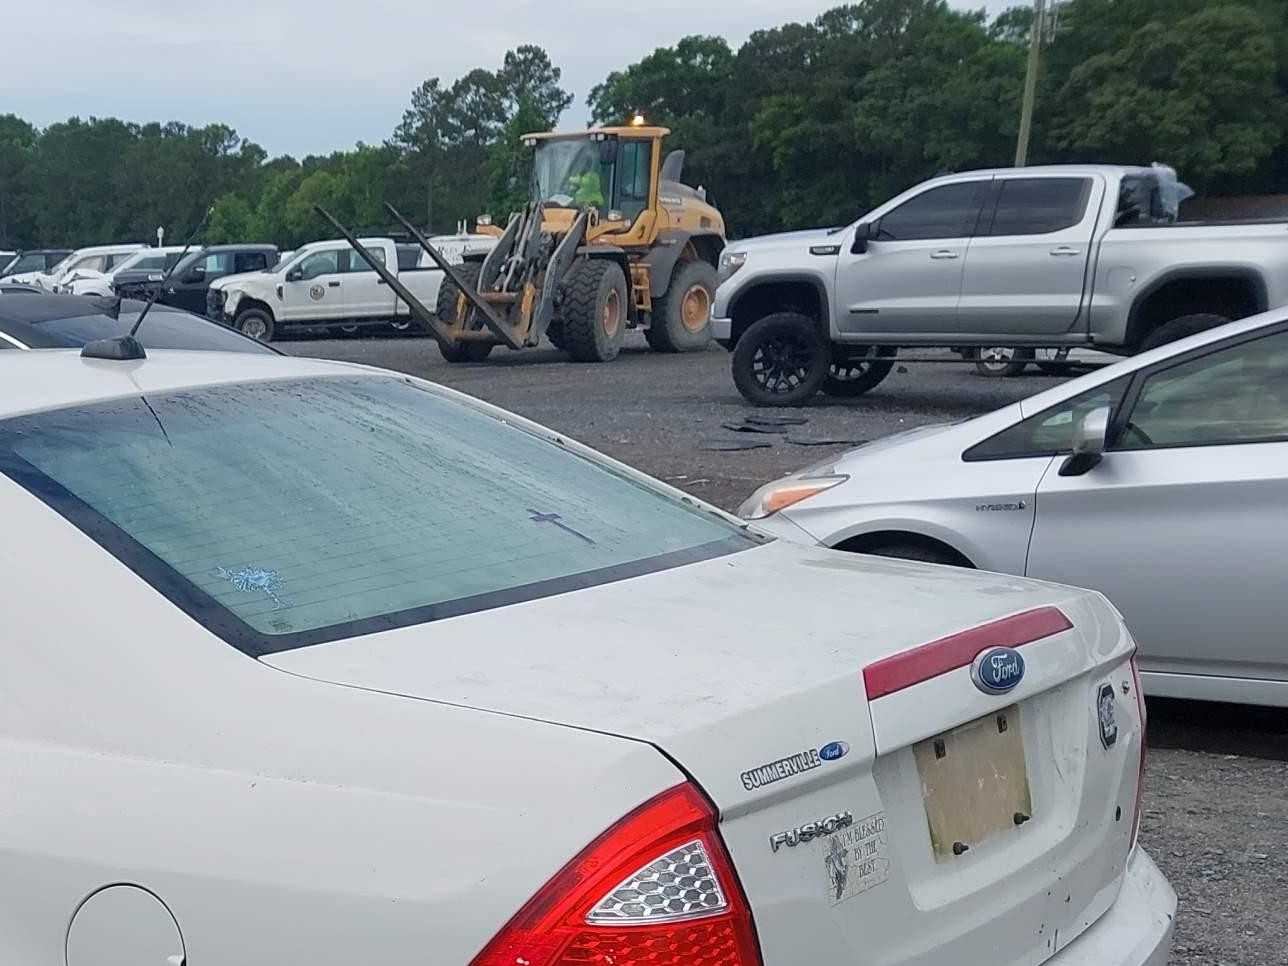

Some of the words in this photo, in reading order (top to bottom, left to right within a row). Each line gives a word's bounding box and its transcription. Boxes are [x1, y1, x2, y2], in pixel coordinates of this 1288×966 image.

[991, 653, 1020, 683] Ford
[740, 749, 821, 791] SUMMERVILLE
[769, 810, 853, 853] FUSION
[854, 846, 863, 861] BY
[865, 840, 878, 857] THE
[858, 859, 876, 878] BEST
